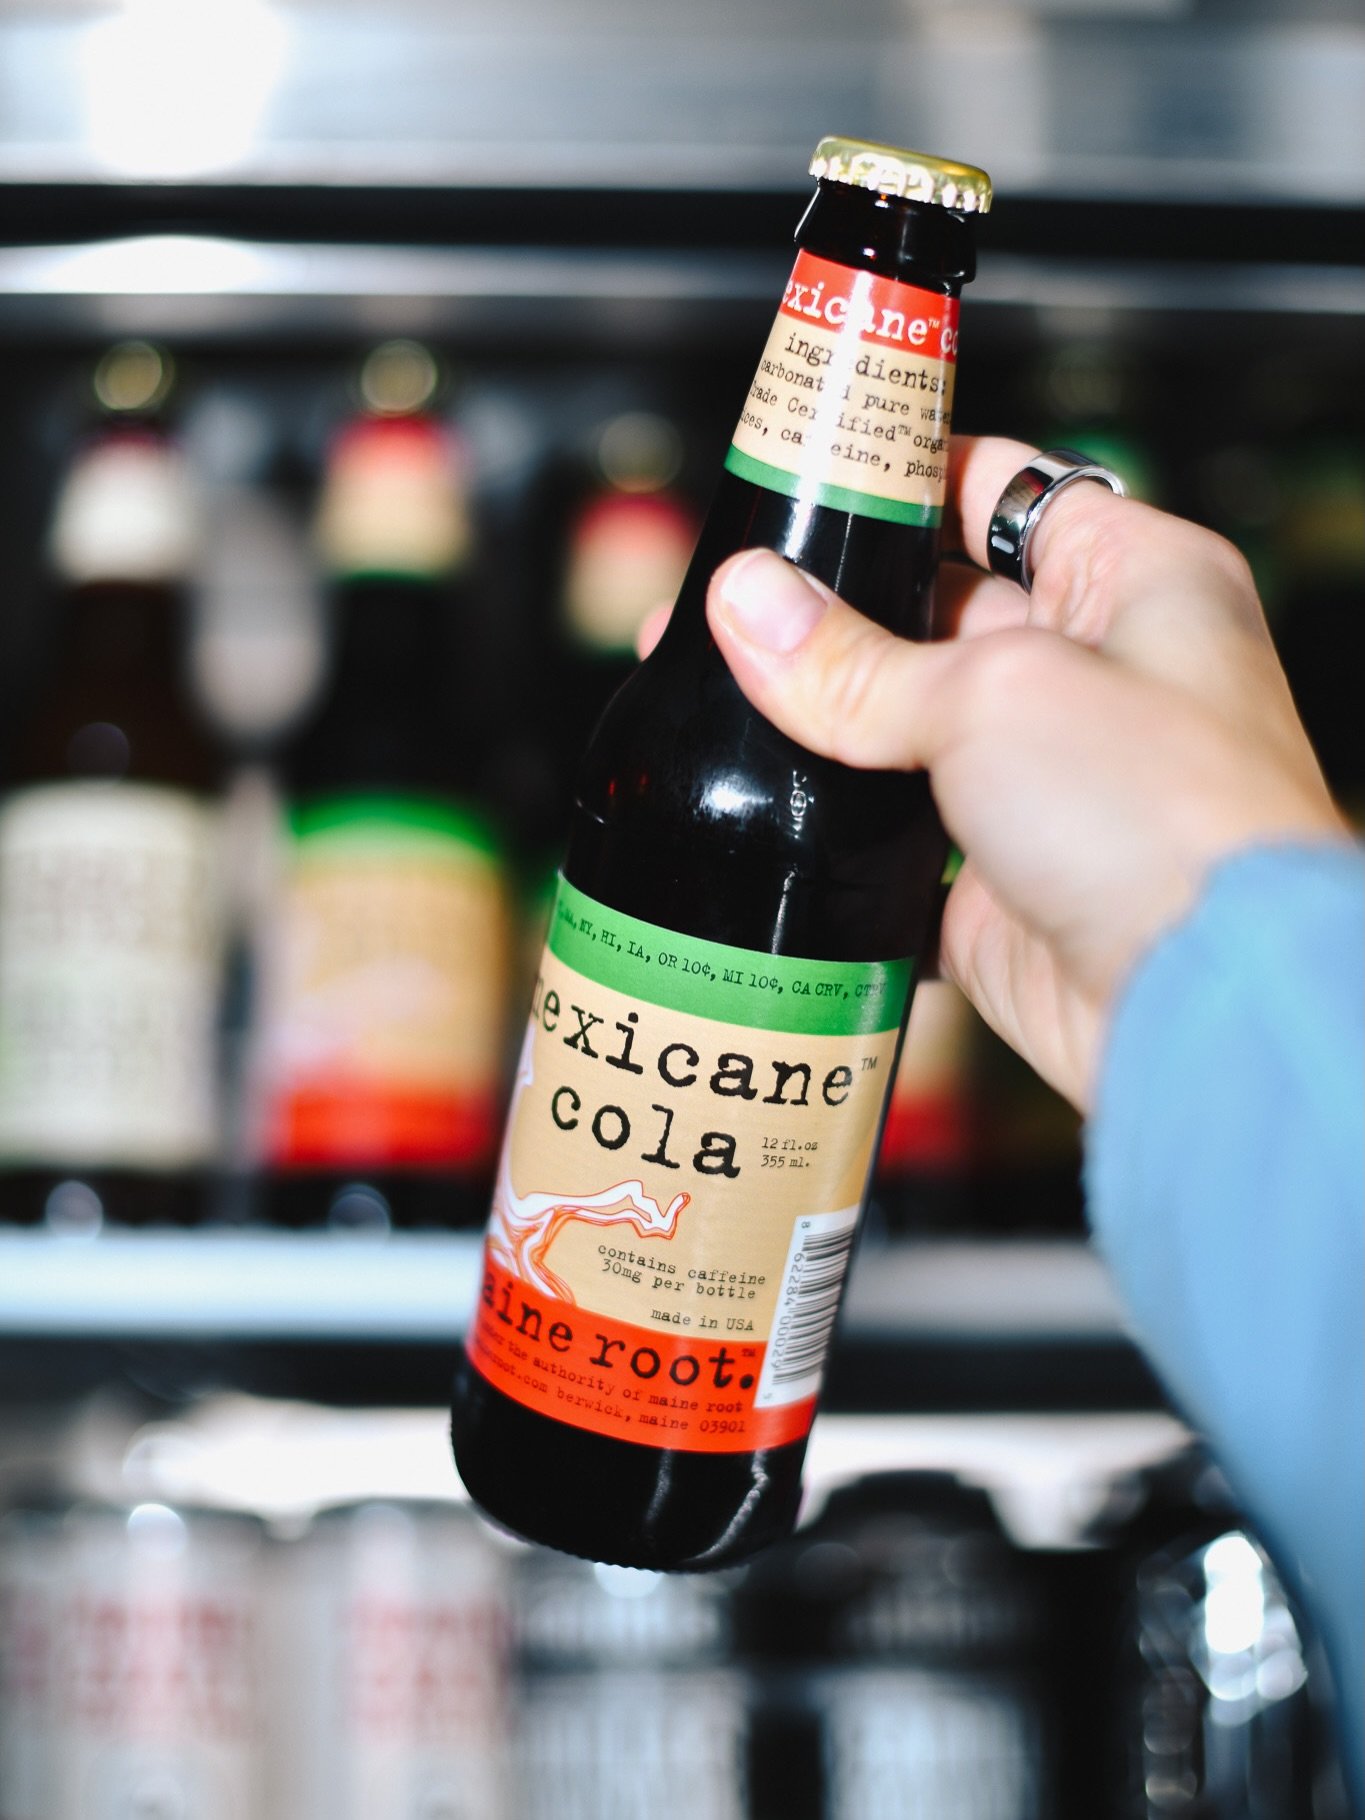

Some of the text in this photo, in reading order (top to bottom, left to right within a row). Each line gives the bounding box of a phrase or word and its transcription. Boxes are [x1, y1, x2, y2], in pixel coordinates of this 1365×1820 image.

[784, 332, 946, 395] ingrdients:
[760, 358, 951, 424] carbonat pure wae
[787, 397, 911, 441] Cerified™
[913, 435, 948, 454] orga
[781, 428, 890, 472] caeine,
[600, 929, 622, 952] HI,
[627, 940, 651, 963] IA,
[658, 952, 678, 969] OR
[722, 968, 744, 985] MI
[792, 981, 811, 996] CA
[815, 982, 849, 1000] CRV,
[551, 1086, 741, 1178] cola
[762, 1137, 778, 1149] 12
[761, 1154, 810, 1168] 355 ml.
[801, 1221, 811, 1229] 8
[598, 1244, 766, 1285] contains caffeine
[602, 1259, 756, 1299] 30mg per bottle
[784, 1252, 805, 1307] 62284
[650, 1308, 754, 1331] made in USA
[508, 1341, 528, 1360] the
[533, 1357, 615, 1396] authority
[622, 1388, 641, 1402] of
[650, 1394, 699, 1411] maine
[706, 1400, 743, 1413] root
[557, 1386, 631, 1423] berwick,
[638, 1413, 689, 1430] maine
[699, 1420, 746, 1434] 03901
